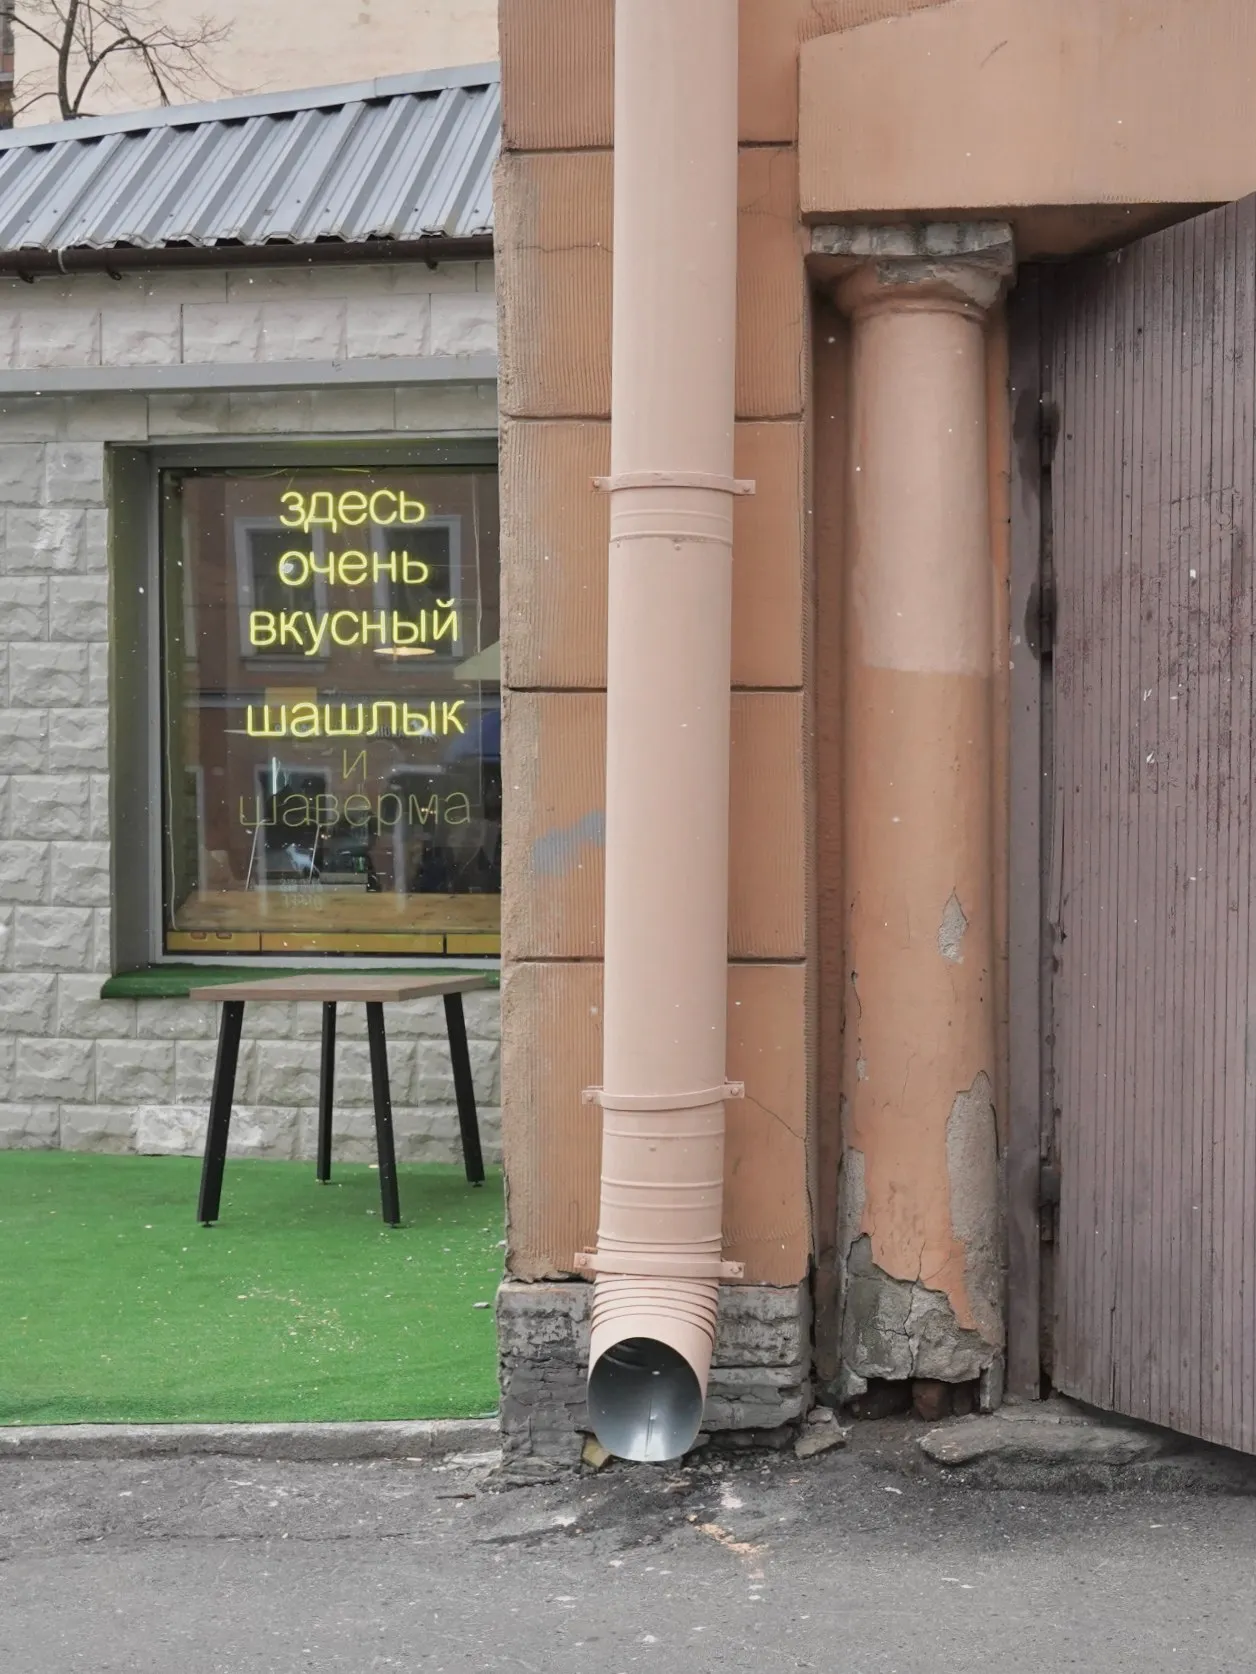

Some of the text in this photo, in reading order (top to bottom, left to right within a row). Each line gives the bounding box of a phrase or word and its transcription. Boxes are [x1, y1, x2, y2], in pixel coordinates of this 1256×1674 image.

[279, 488, 427, 534] здесь
[278, 549, 430, 587] очень
[248, 597, 461, 657] вкусный
[246, 699, 467, 738] шашлык
[342, 749, 368, 782] и
[238, 791, 472, 837] шаверма
